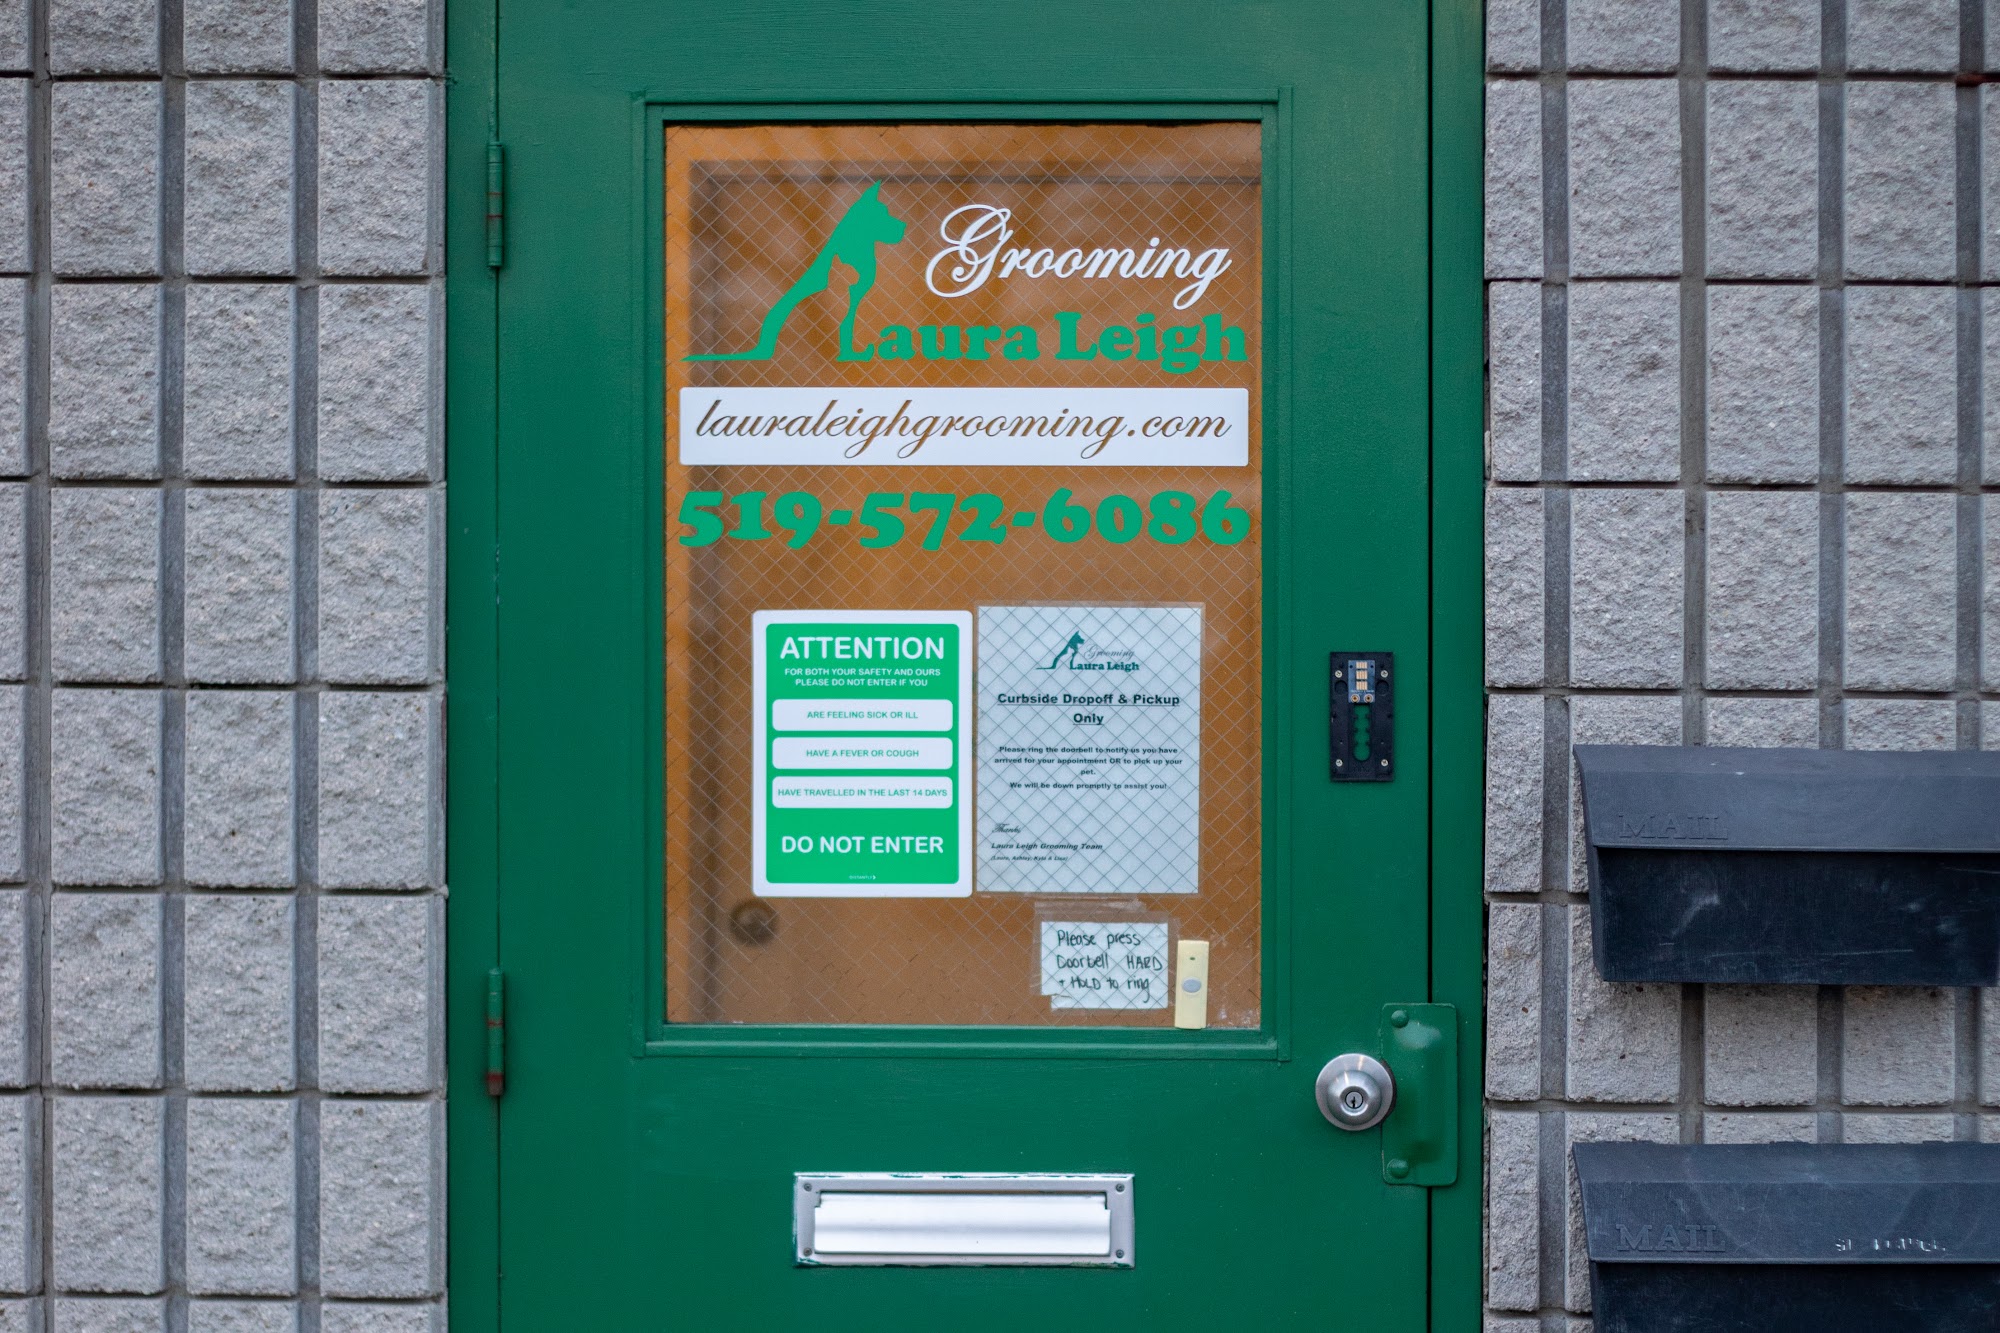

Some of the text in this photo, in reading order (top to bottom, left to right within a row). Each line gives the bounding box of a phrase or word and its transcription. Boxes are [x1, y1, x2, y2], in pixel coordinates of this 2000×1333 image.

[925, 204, 1232, 310] Grooming
[836, 312, 1248, 374] Laura Leigh
[695, 399, 1232, 459] lauraleighgrooming.com
[678, 488, 1251, 551] 519-572-6086
[780, 637, 944, 660] ATTENTION
[1084, 644, 1134, 660] Grooming
[784, 668, 941, 676] FOR BOTH YOUR SAFETY AND OURS
[1070, 662, 1140, 672] Laura Leigh
[795, 678, 928, 686] PLEASE DO NOT ENTER IF YOU
[997, 694, 1180, 706] Curbside Dropoff & Pickup
[807, 711, 918, 719] ARE FEELING SICK OR ILL
[1073, 713, 1104, 725] Only
[1618, 812, 1728, 841] MAIL
[781, 836, 944, 854] DO NOT ENTER
[1057, 930, 1141, 949] Please press
[1127, 955, 1163, 971] HARD
[1107, 977, 1119, 989] to
[1127, 975, 1150, 1004] ring
[1616, 1223, 1726, 1253] MAIL
